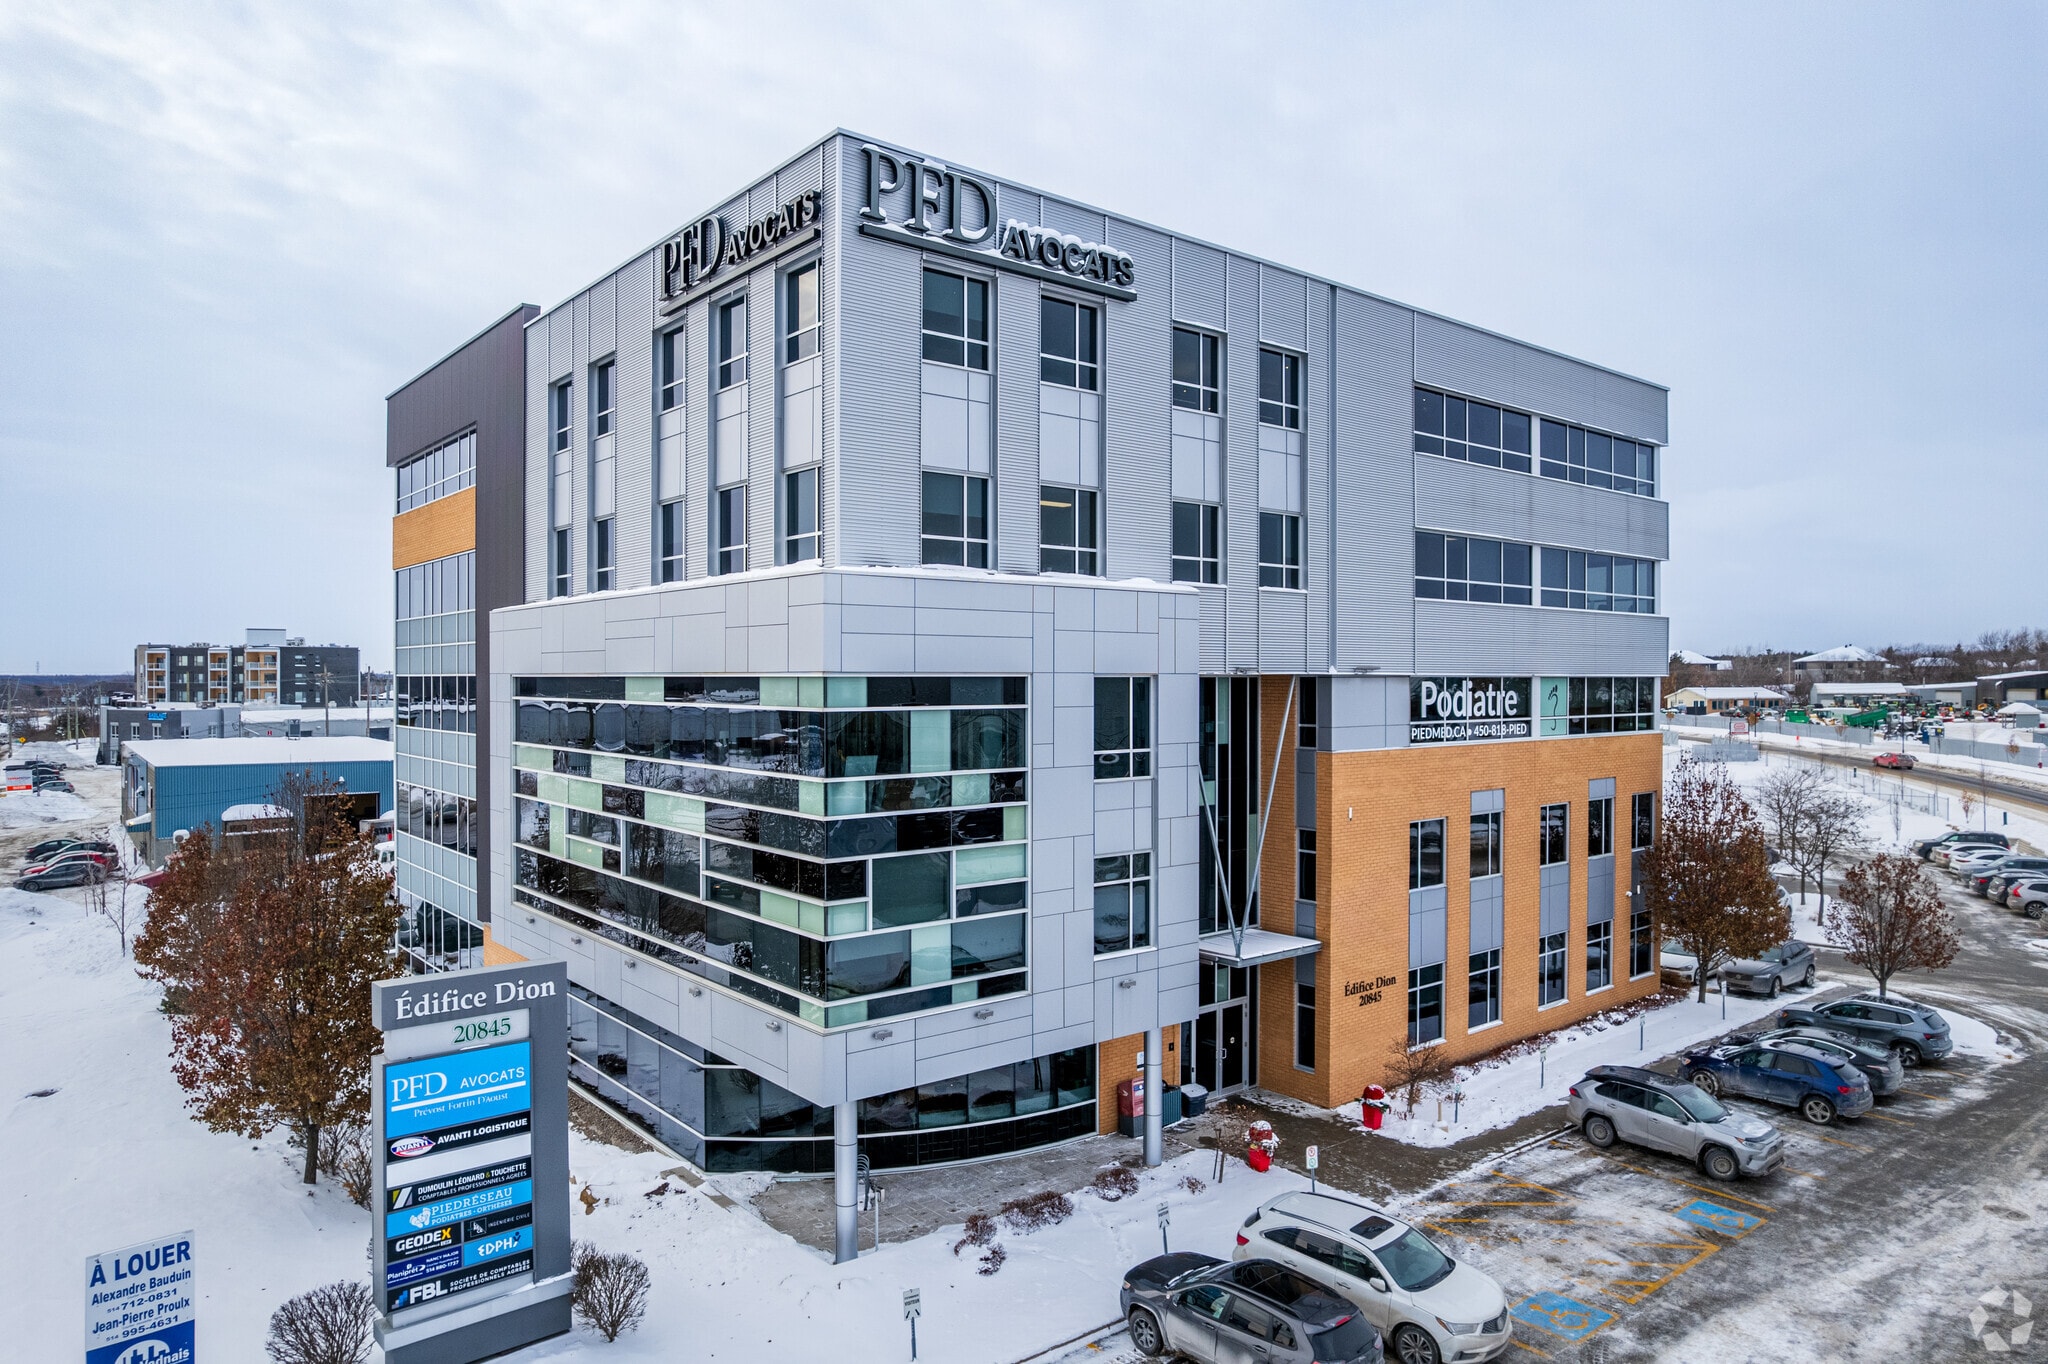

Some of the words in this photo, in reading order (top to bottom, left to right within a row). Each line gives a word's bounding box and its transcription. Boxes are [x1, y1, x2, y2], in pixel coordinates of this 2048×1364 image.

[859, 144, 998, 243] PFD
[727, 189, 822, 265] AVOCATS
[659, 213, 726, 301] PFD
[1000, 225, 1135, 286] AVOCATS
[1421, 680, 1518, 718] Podiatre
[1411, 726, 1466, 740] PIEDMED.CA
[395, 989, 487, 1020] Édifice
[494, 979, 556, 1005] Dion
[1344, 981, 1374, 997] Édifice
[1376, 975, 1397, 989] Dion
[1359, 991, 1382, 1007] 20845
[453, 1017, 511, 1044] 20845
[391, 1072, 448, 1103] PFD
[460, 1066, 525, 1089] AVOCATS
[437, 1130, 471, 1145] AVANTI
[473, 1118, 528, 1136] LOGISTIQUE
[396, 1140, 429, 1152] AVANTI
[418, 1180, 454, 1195] DUMOULIN
[454, 1172, 485, 1186] LÉONARD
[491, 1162, 526, 1177] TOUCHETTE
[418, 1188, 457, 1202] COMPTABLES
[458, 1177, 505, 1192] PROFESSIONNELS
[431, 1187, 513, 1216] PIEDRÉSEAU
[431, 1210, 472, 1226] PODIATRES
[395, 1227, 452, 1252] GEODEX
[114, 1240, 191, 1281] LOUER
[490, 1259, 530, 1275] COMPTABLES
[91, 1283, 146, 1306] Alexandre
[149, 1268, 191, 1290] Bauduin
[409, 1280, 448, 1304] FBL
[450, 1271, 505, 1293] PROFESSIONNELS
[121, 1288, 178, 1311] 712-0831
[92, 1309, 154, 1335] Jean-Pierre
[157, 1296, 190, 1315] Proulx
[122, 1315, 179, 1338] 995-4631
